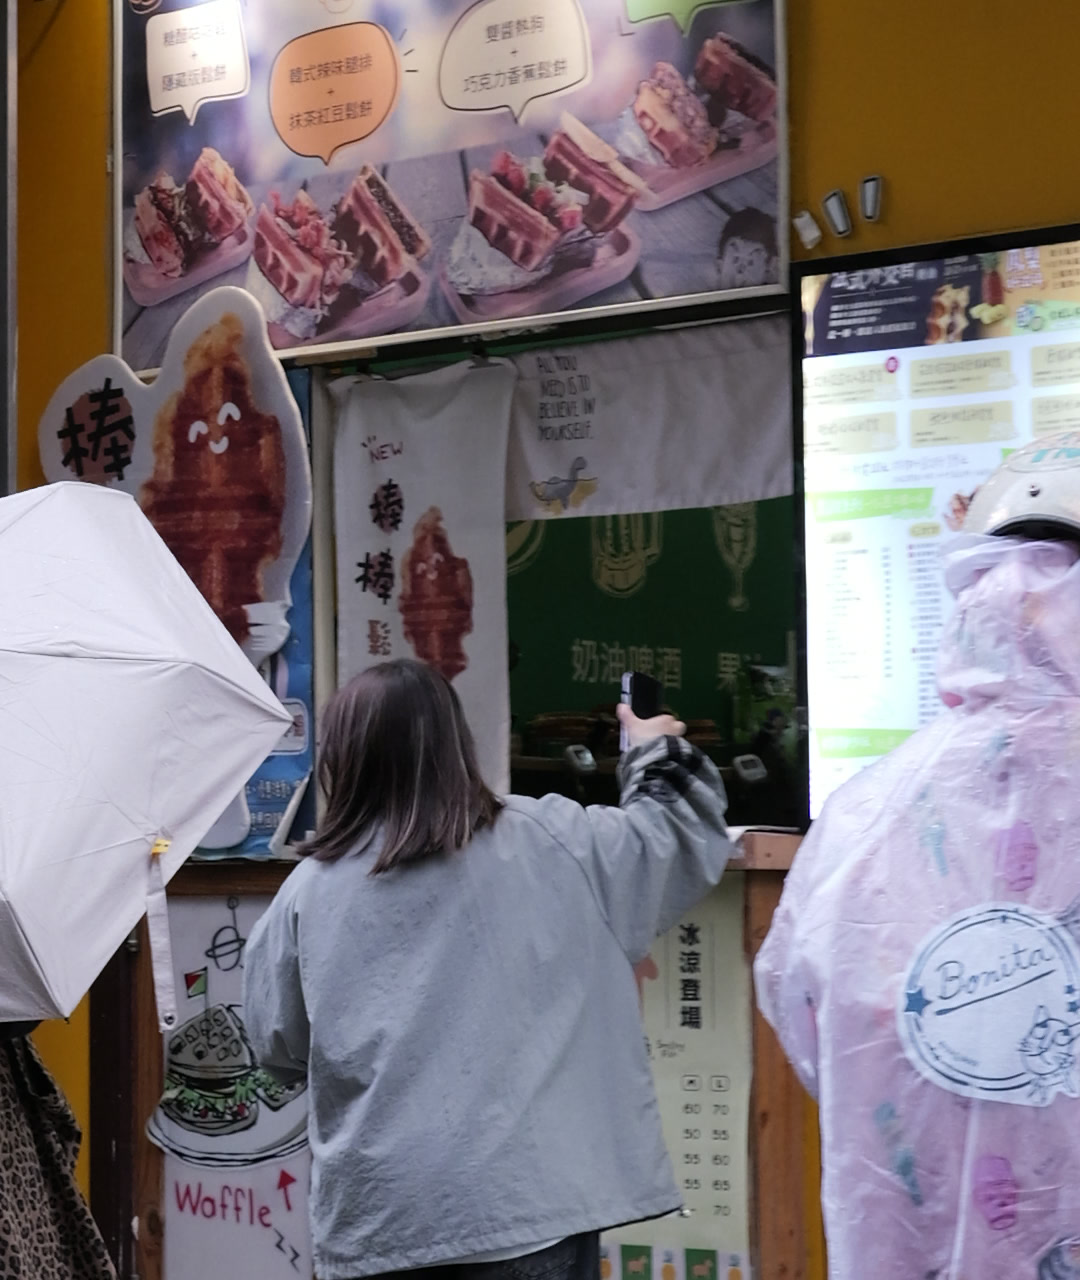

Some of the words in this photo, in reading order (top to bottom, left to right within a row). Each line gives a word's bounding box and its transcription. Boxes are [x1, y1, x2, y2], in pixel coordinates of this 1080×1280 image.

[57, 377, 136, 481] 棒
[370, 441, 404, 463] NEW
[936, 943, 1052, 1000] Bonita
[174, 1180, 272, 1228] Waffle
